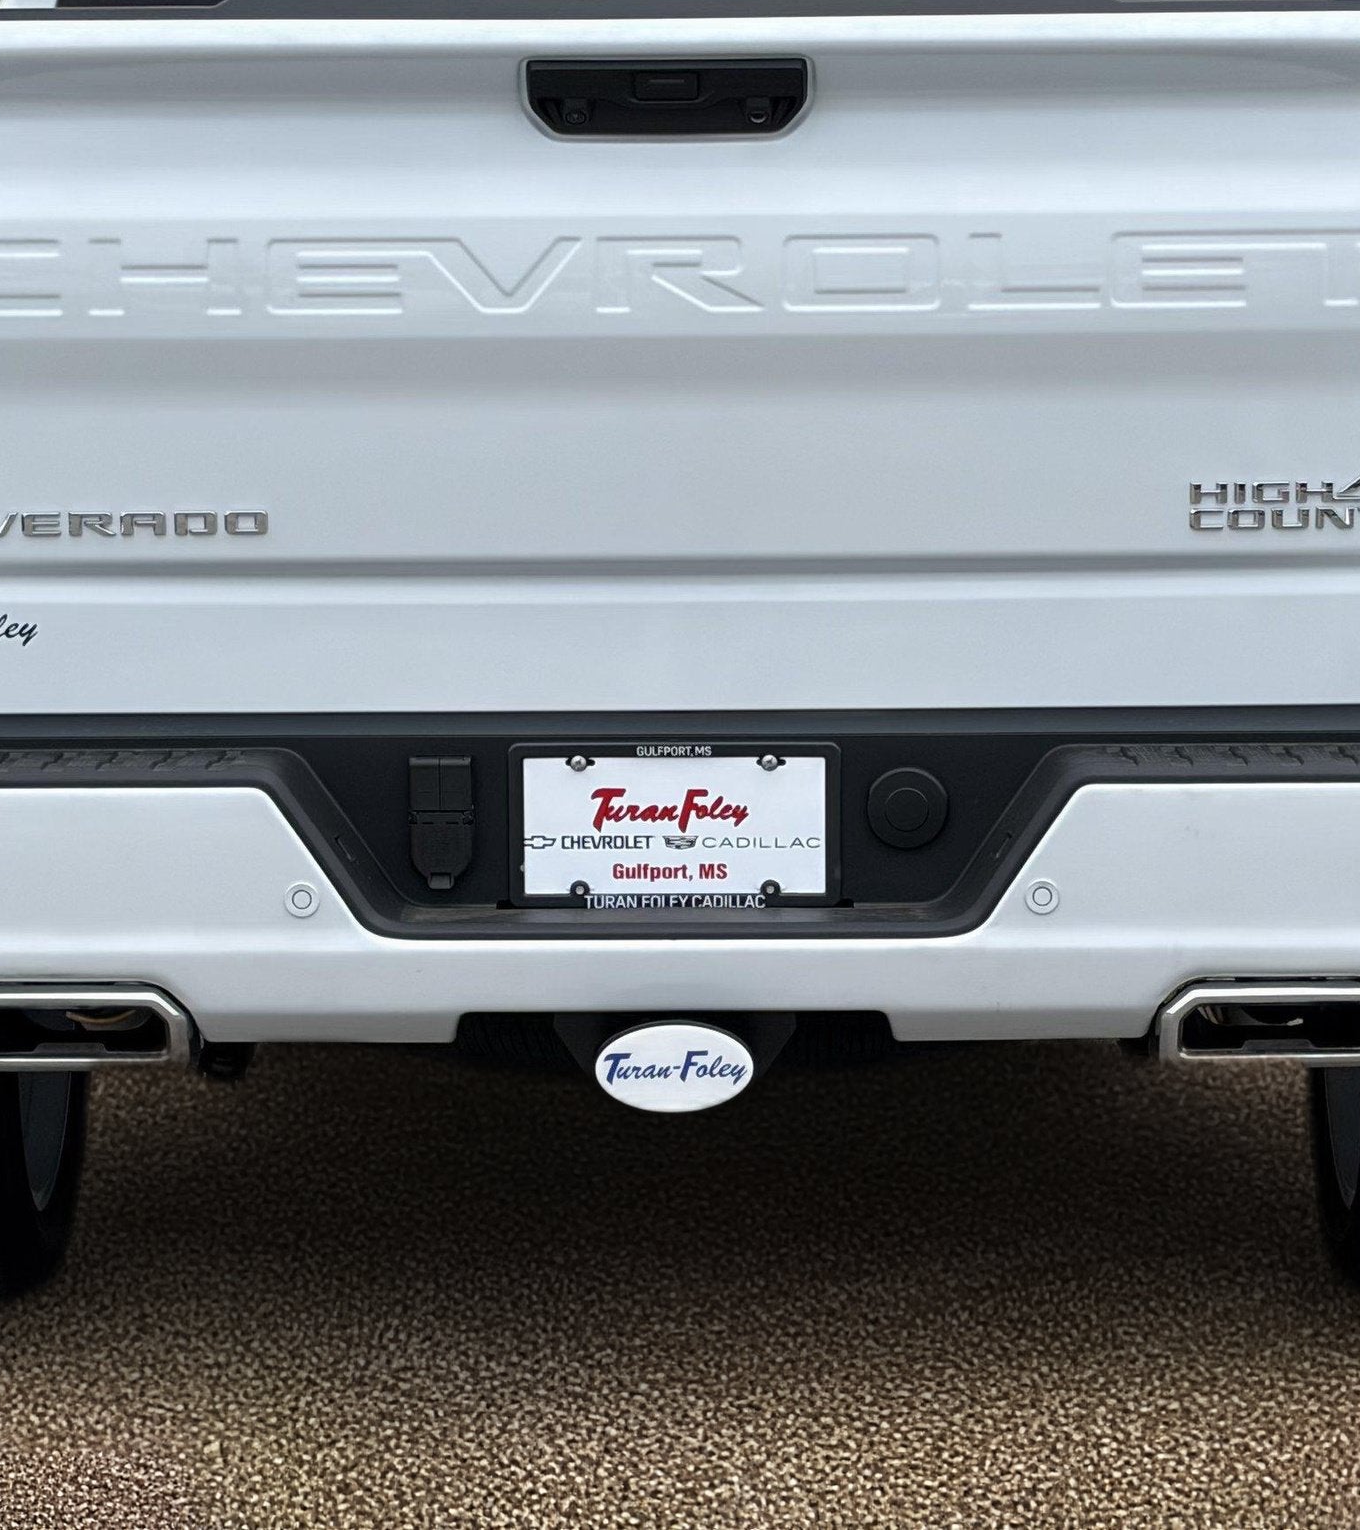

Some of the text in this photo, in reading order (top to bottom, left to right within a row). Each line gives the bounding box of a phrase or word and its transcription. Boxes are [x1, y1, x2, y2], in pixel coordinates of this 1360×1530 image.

[1190, 481, 1337, 504] HIGH
[561, 835, 822, 850] CHEVROLET CADILLAC
[612, 863, 728, 883] Gulfport, MS
[584, 895, 637, 909] TURAN
[691, 895, 766, 909] CADILLAC
[603, 1049, 748, 1086] Turan-Foley
